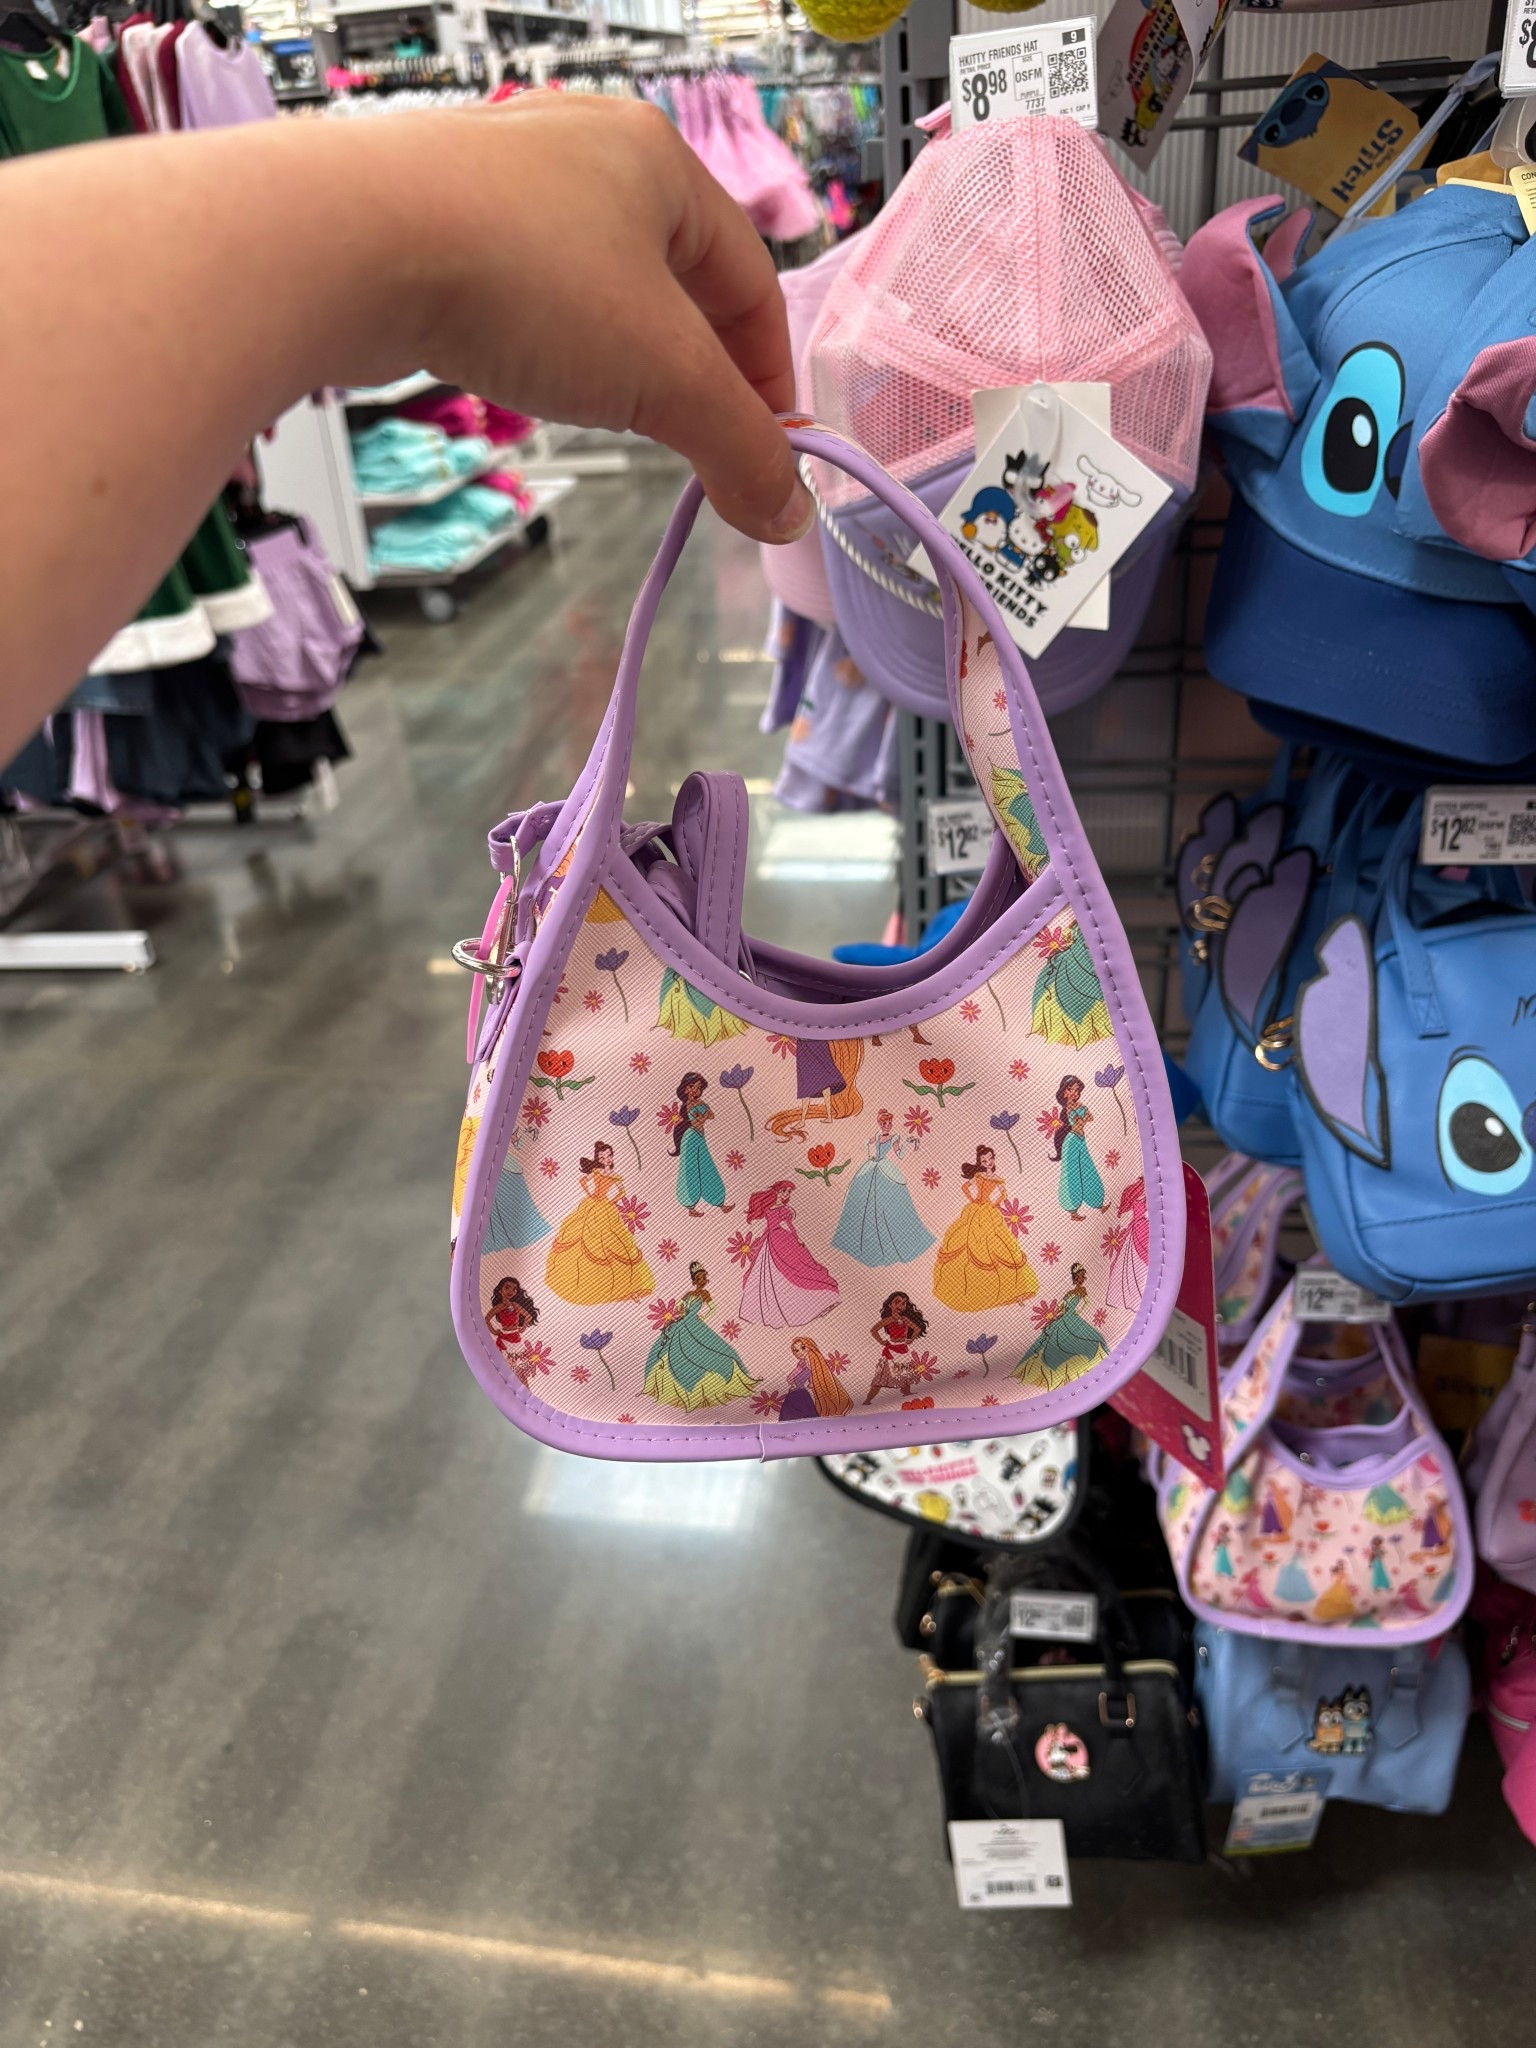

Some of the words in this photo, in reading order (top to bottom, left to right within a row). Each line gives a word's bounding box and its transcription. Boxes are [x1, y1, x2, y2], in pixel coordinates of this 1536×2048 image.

[1070, 31, 1077, 43] 9
[1149, 7, 1177, 60] FRIEND
[959, 51, 987, 69] HKITTY
[988, 43, 1022, 61] FRIENDS
[1023, 40, 1038, 53] HAT
[1015, 67, 1042, 83] OSFM
[1025, 97, 1046, 109] 7737
[980, 576, 1037, 628] RIENDS
[996, 572, 1048, 615] KITTY
